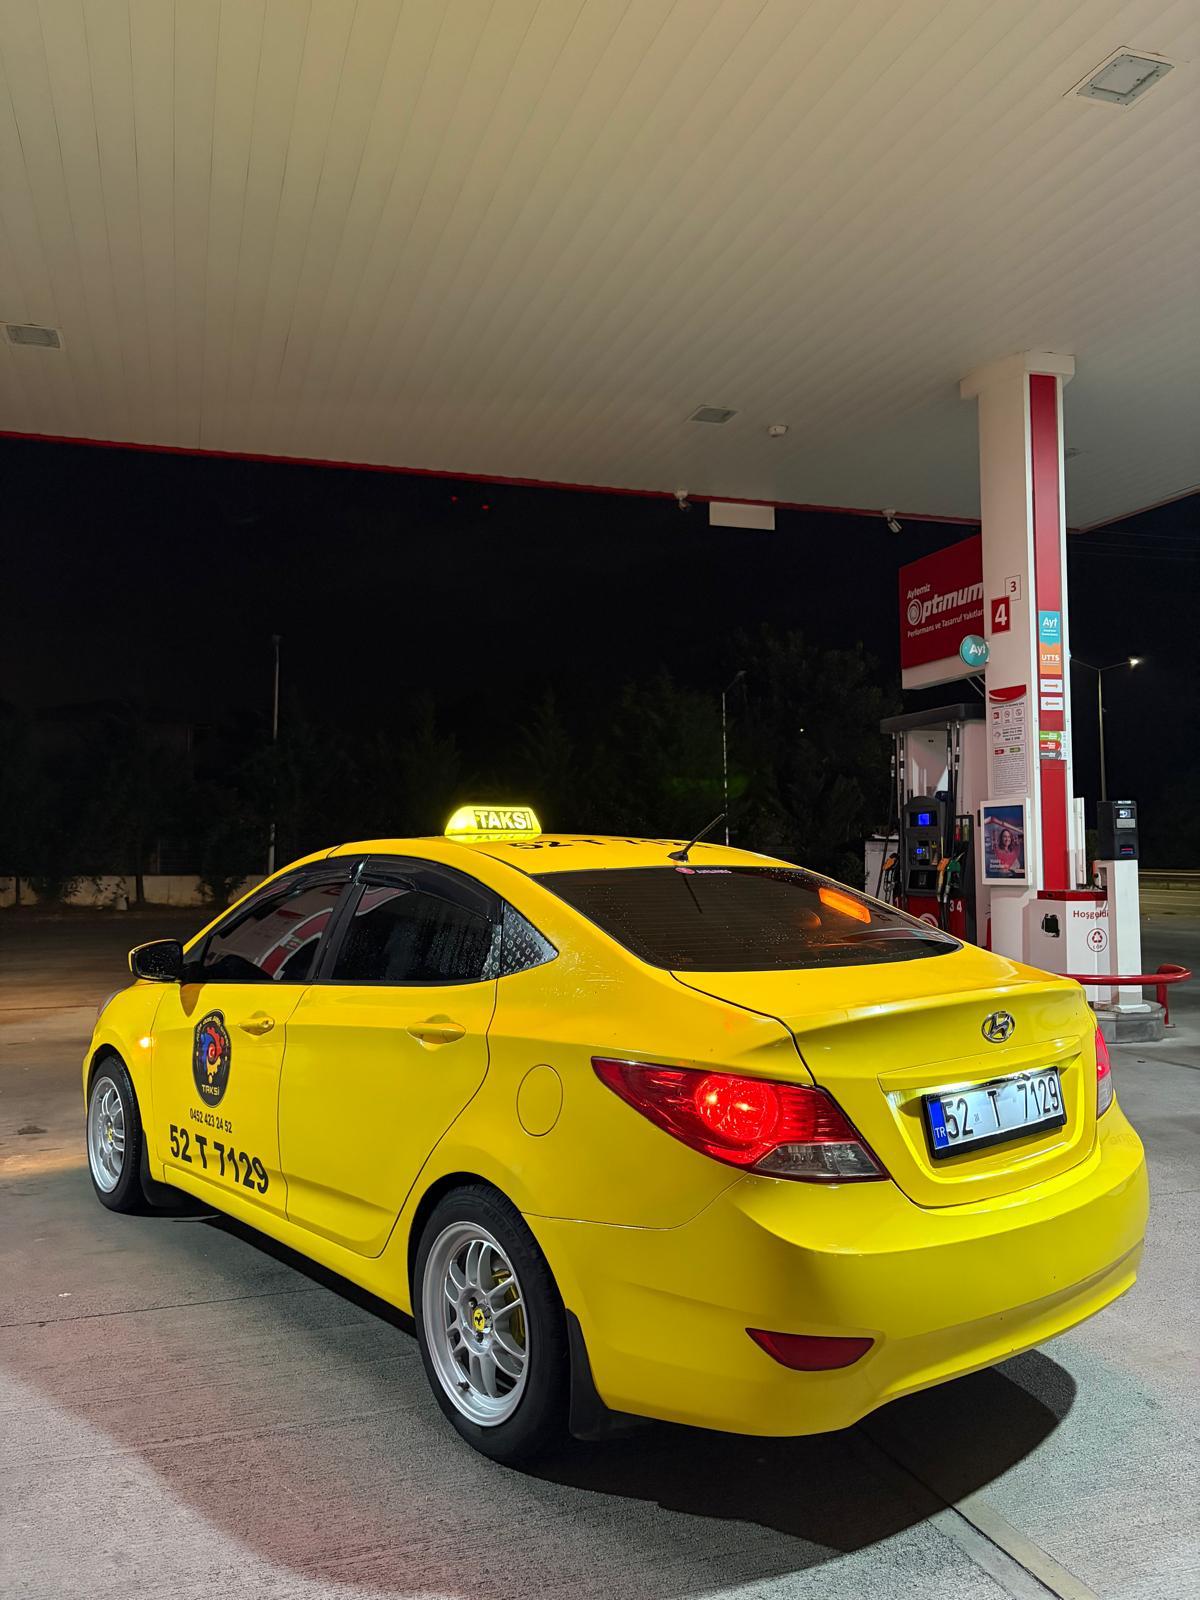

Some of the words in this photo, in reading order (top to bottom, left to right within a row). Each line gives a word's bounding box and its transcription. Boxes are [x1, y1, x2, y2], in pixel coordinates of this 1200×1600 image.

[1010, 581, 1017, 592] 3
[942, 614, 963, 628] Tasarruf
[994, 603, 1007, 626] 4
[1041, 654, 1060, 662] UTTS
[507, 840, 573, 849] 52
[956, 901, 962, 913] 4
[1073, 910, 1109, 920] Hoşgeldi
[942, 1098, 974, 1139] 52
[987, 1090, 1001, 1128] T
[1017, 1076, 1060, 1120] 7129
[189, 1107, 204, 1124] 0452
[204, 1113, 216, 1128] 423
[215, 1116, 224, 1131] 24
[224, 1120, 233, 1134] 52
[934, 1126, 947, 1139] TR
[169, 1123, 193, 1163] 52
[195, 1133, 208, 1170] T
[213, 1141, 270, 1195] 7129
